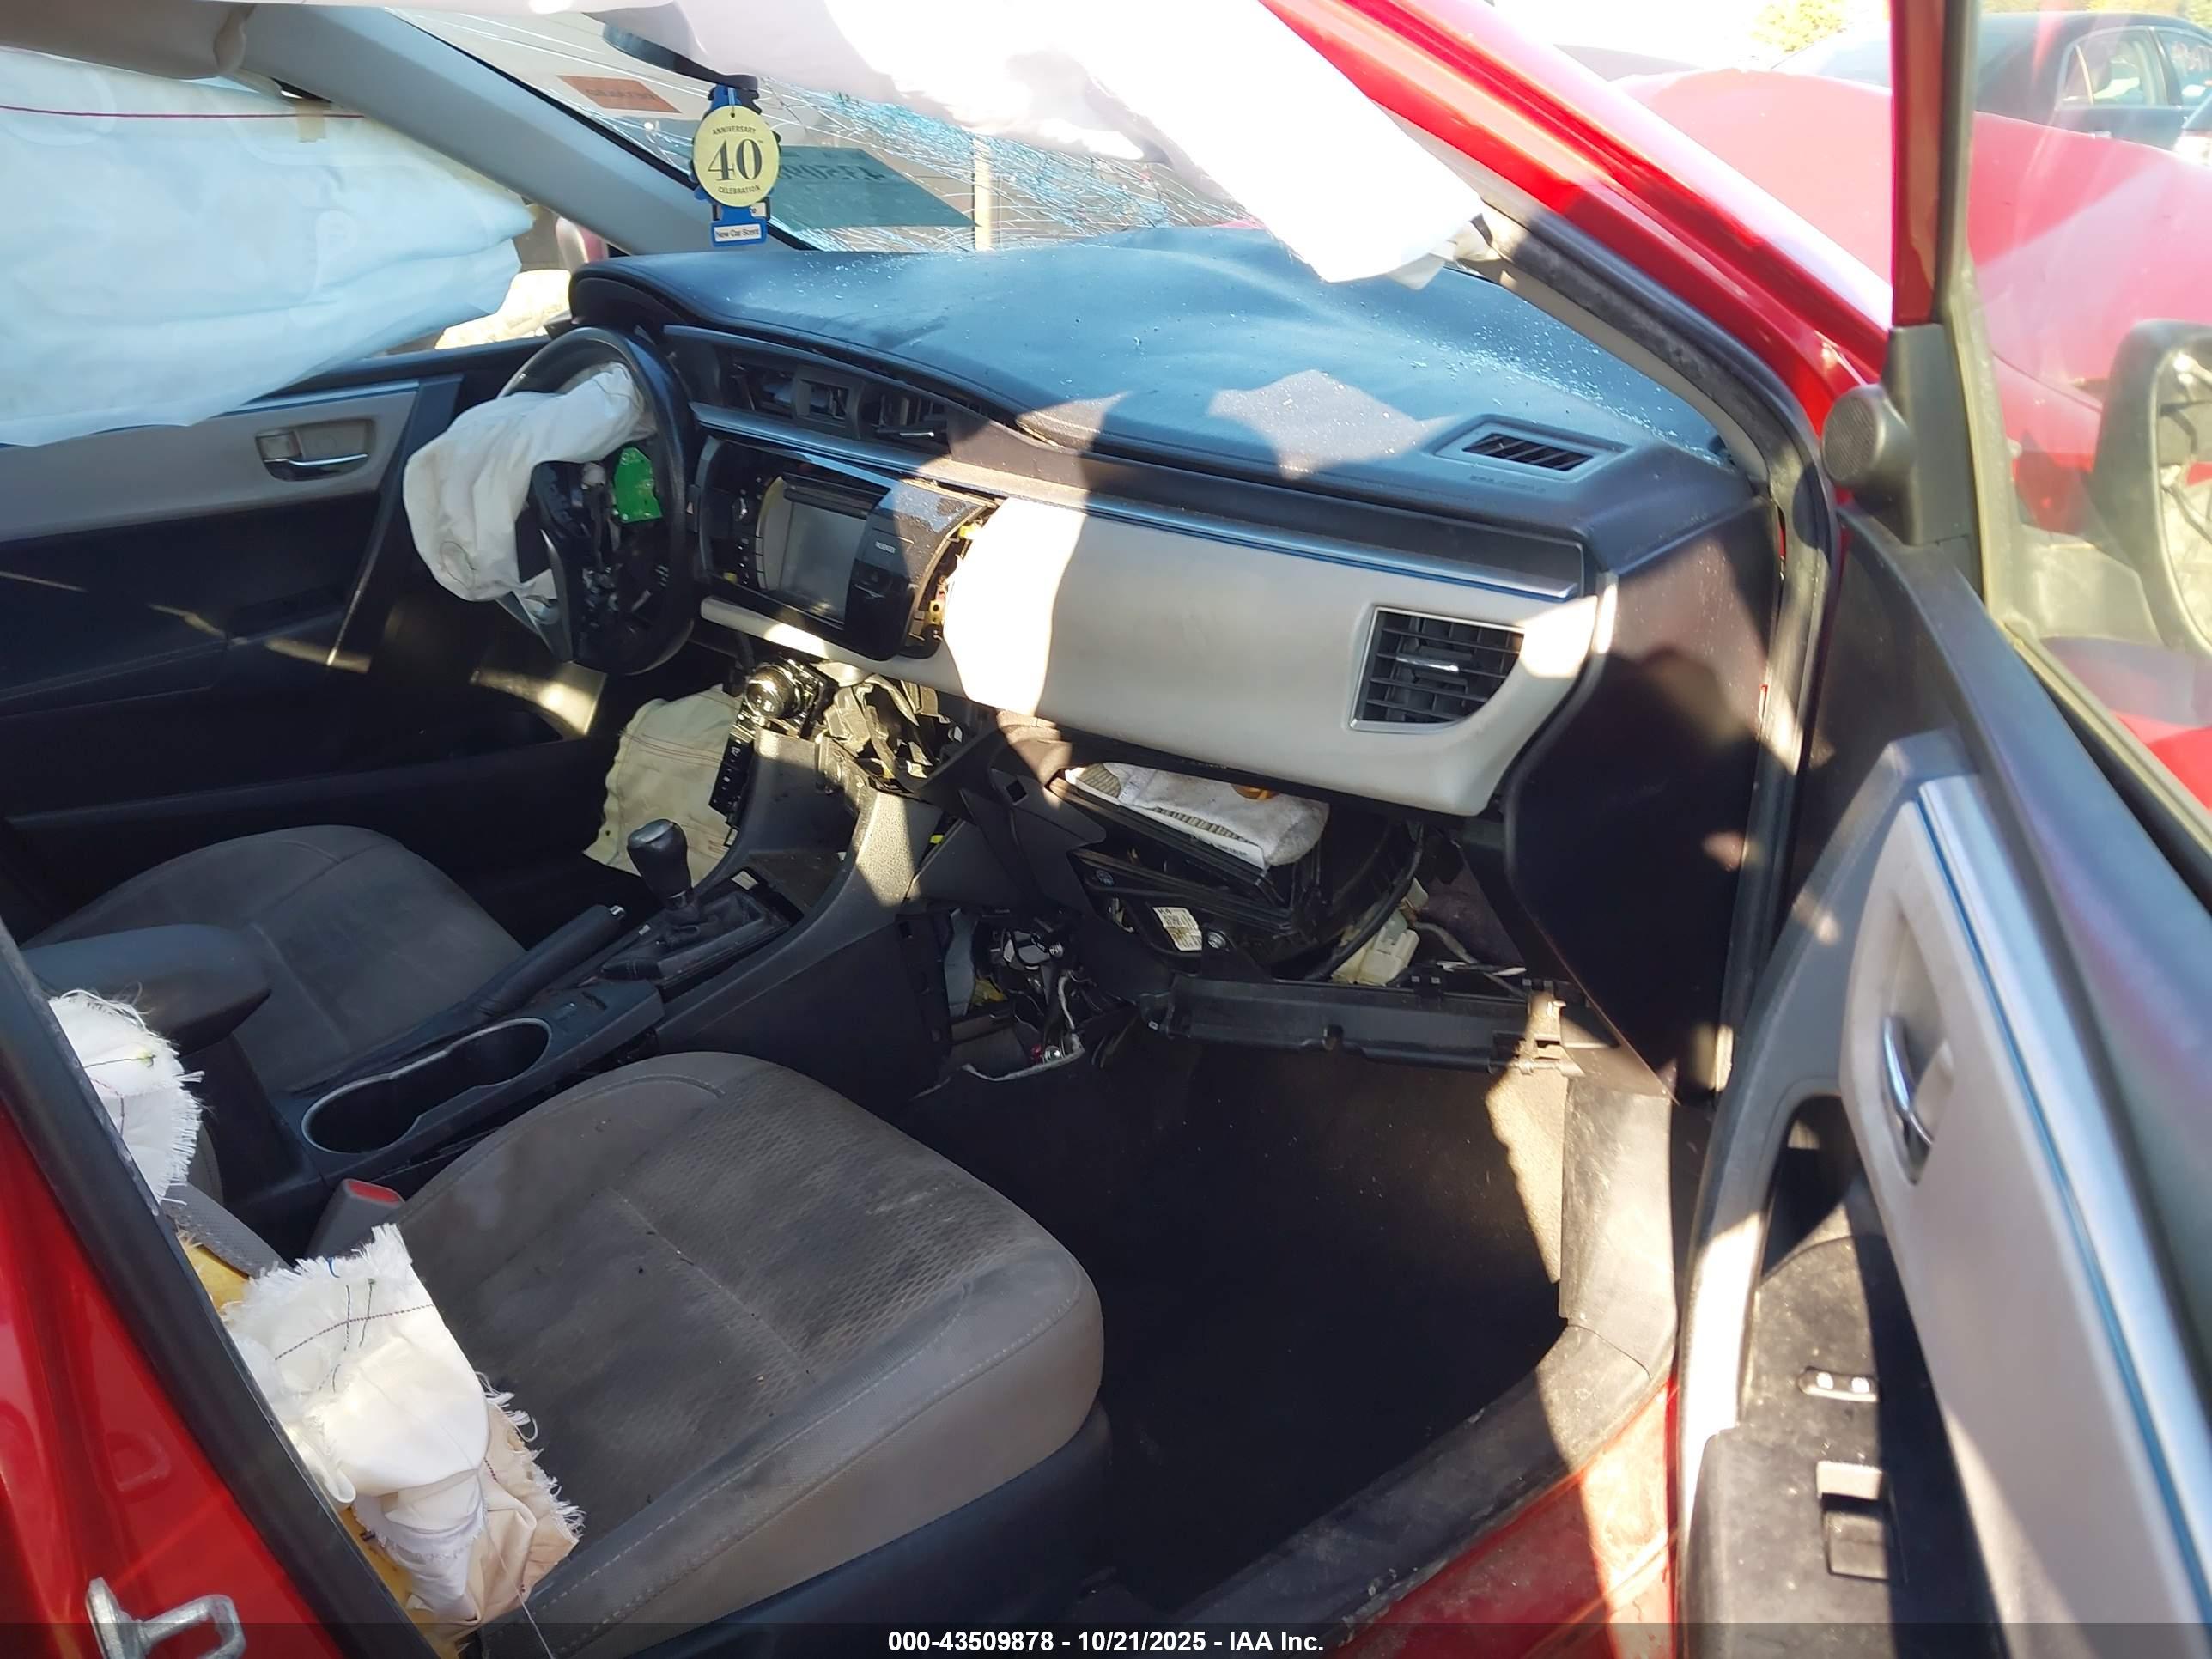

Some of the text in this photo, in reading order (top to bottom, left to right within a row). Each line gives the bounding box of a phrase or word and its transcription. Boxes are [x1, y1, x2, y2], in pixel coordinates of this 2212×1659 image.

[713, 125, 756, 136] ANNIVERSARY
[718, 185, 760, 195] CELEBRATION
[715, 229, 729, 239] New
[730, 228, 741, 238] Car
